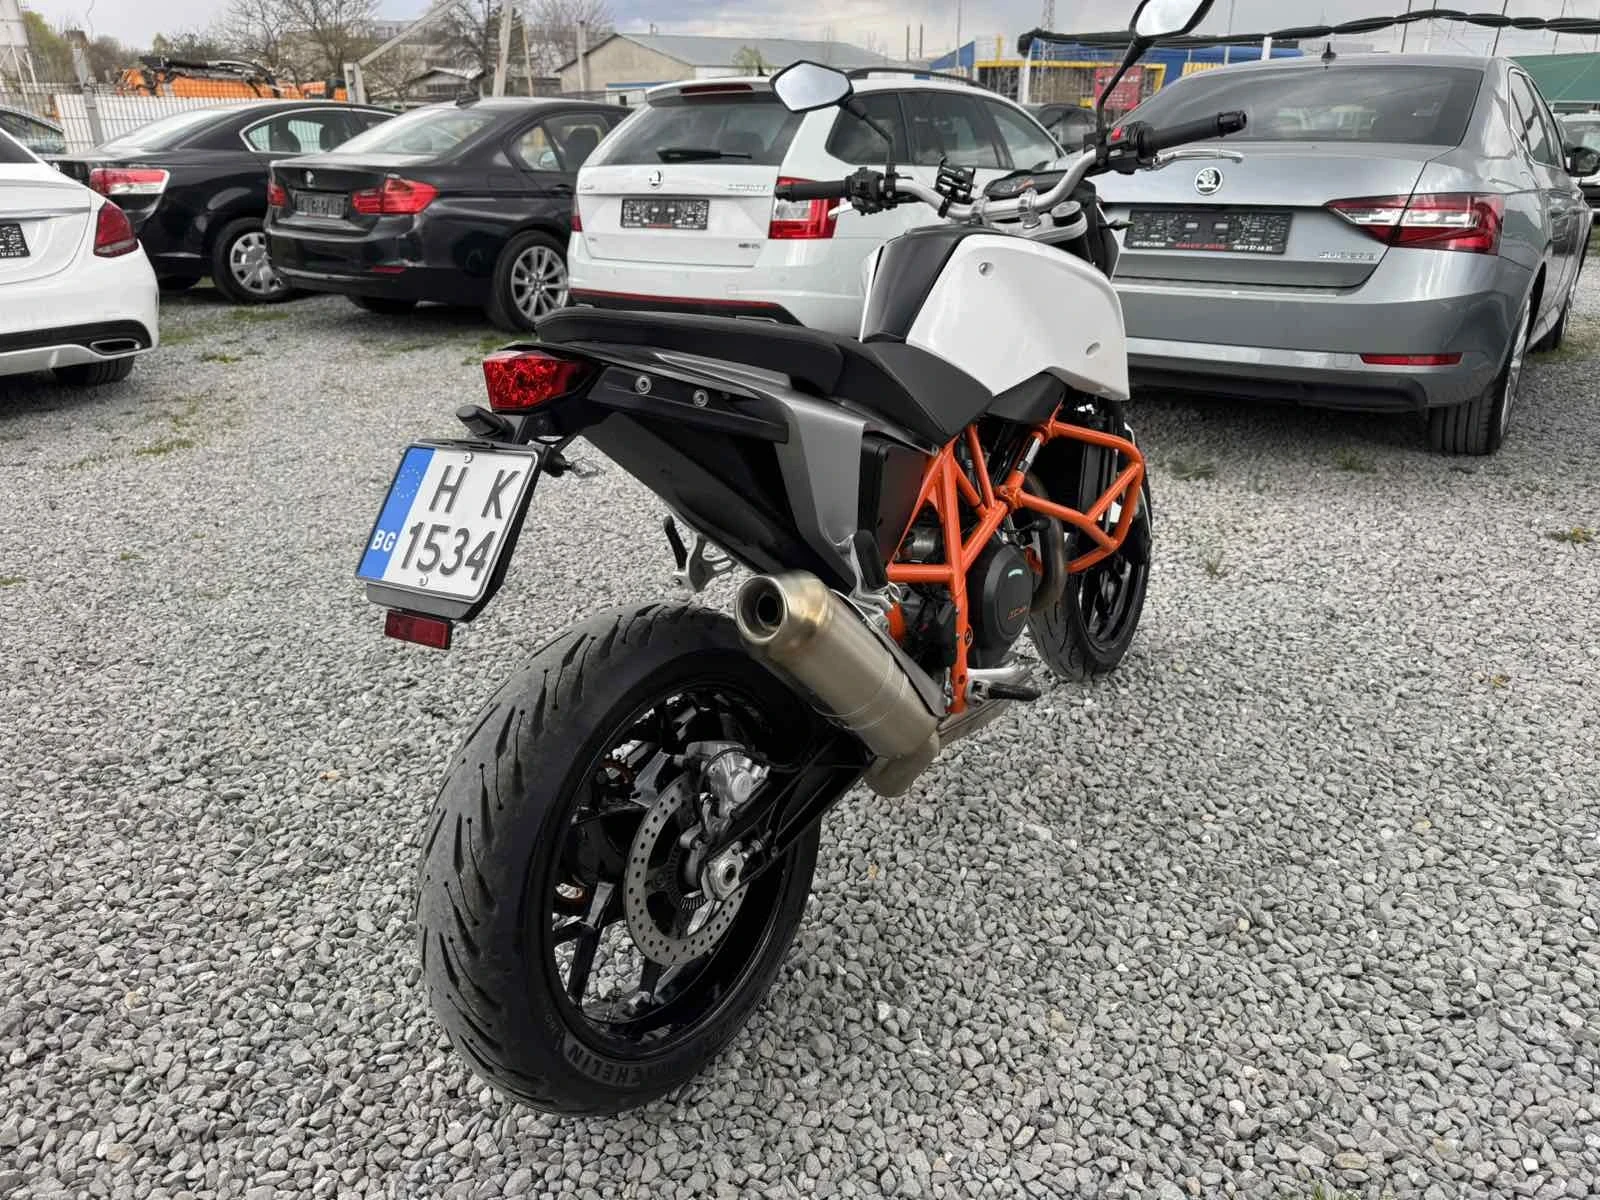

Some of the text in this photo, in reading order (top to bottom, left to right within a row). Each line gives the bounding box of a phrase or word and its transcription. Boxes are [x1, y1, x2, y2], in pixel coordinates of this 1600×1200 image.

[428, 464, 522, 520] H K
[370, 529, 398, 552] BG
[400, 520, 496, 582] 1534
